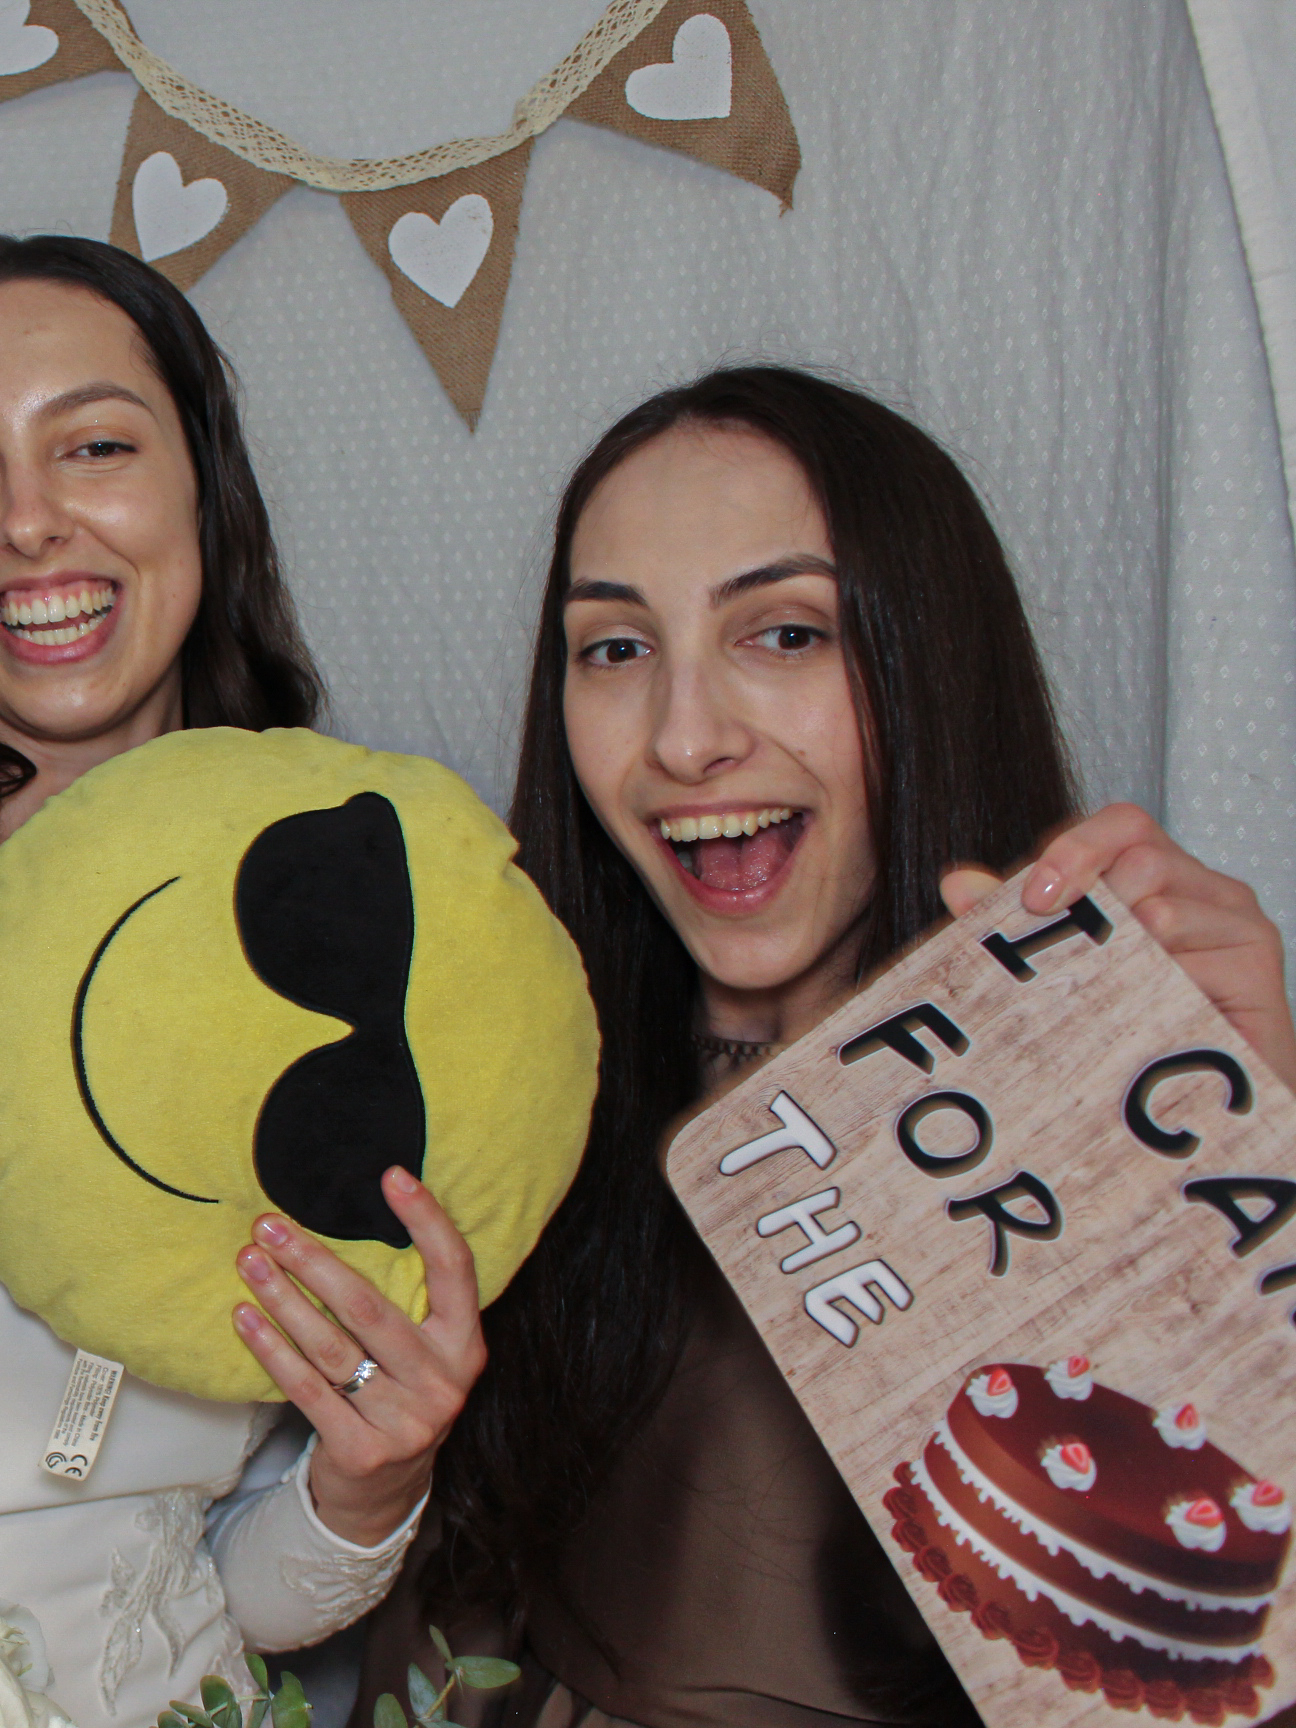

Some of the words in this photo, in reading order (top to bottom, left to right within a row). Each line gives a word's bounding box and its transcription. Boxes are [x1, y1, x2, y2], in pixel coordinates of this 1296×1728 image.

[719, 1089, 914, 1348] THE
[838, 1002, 1065, 1277] FOR
[979, 895, 1115, 983] I
[1120, 1048, 1296, 1330] CA
